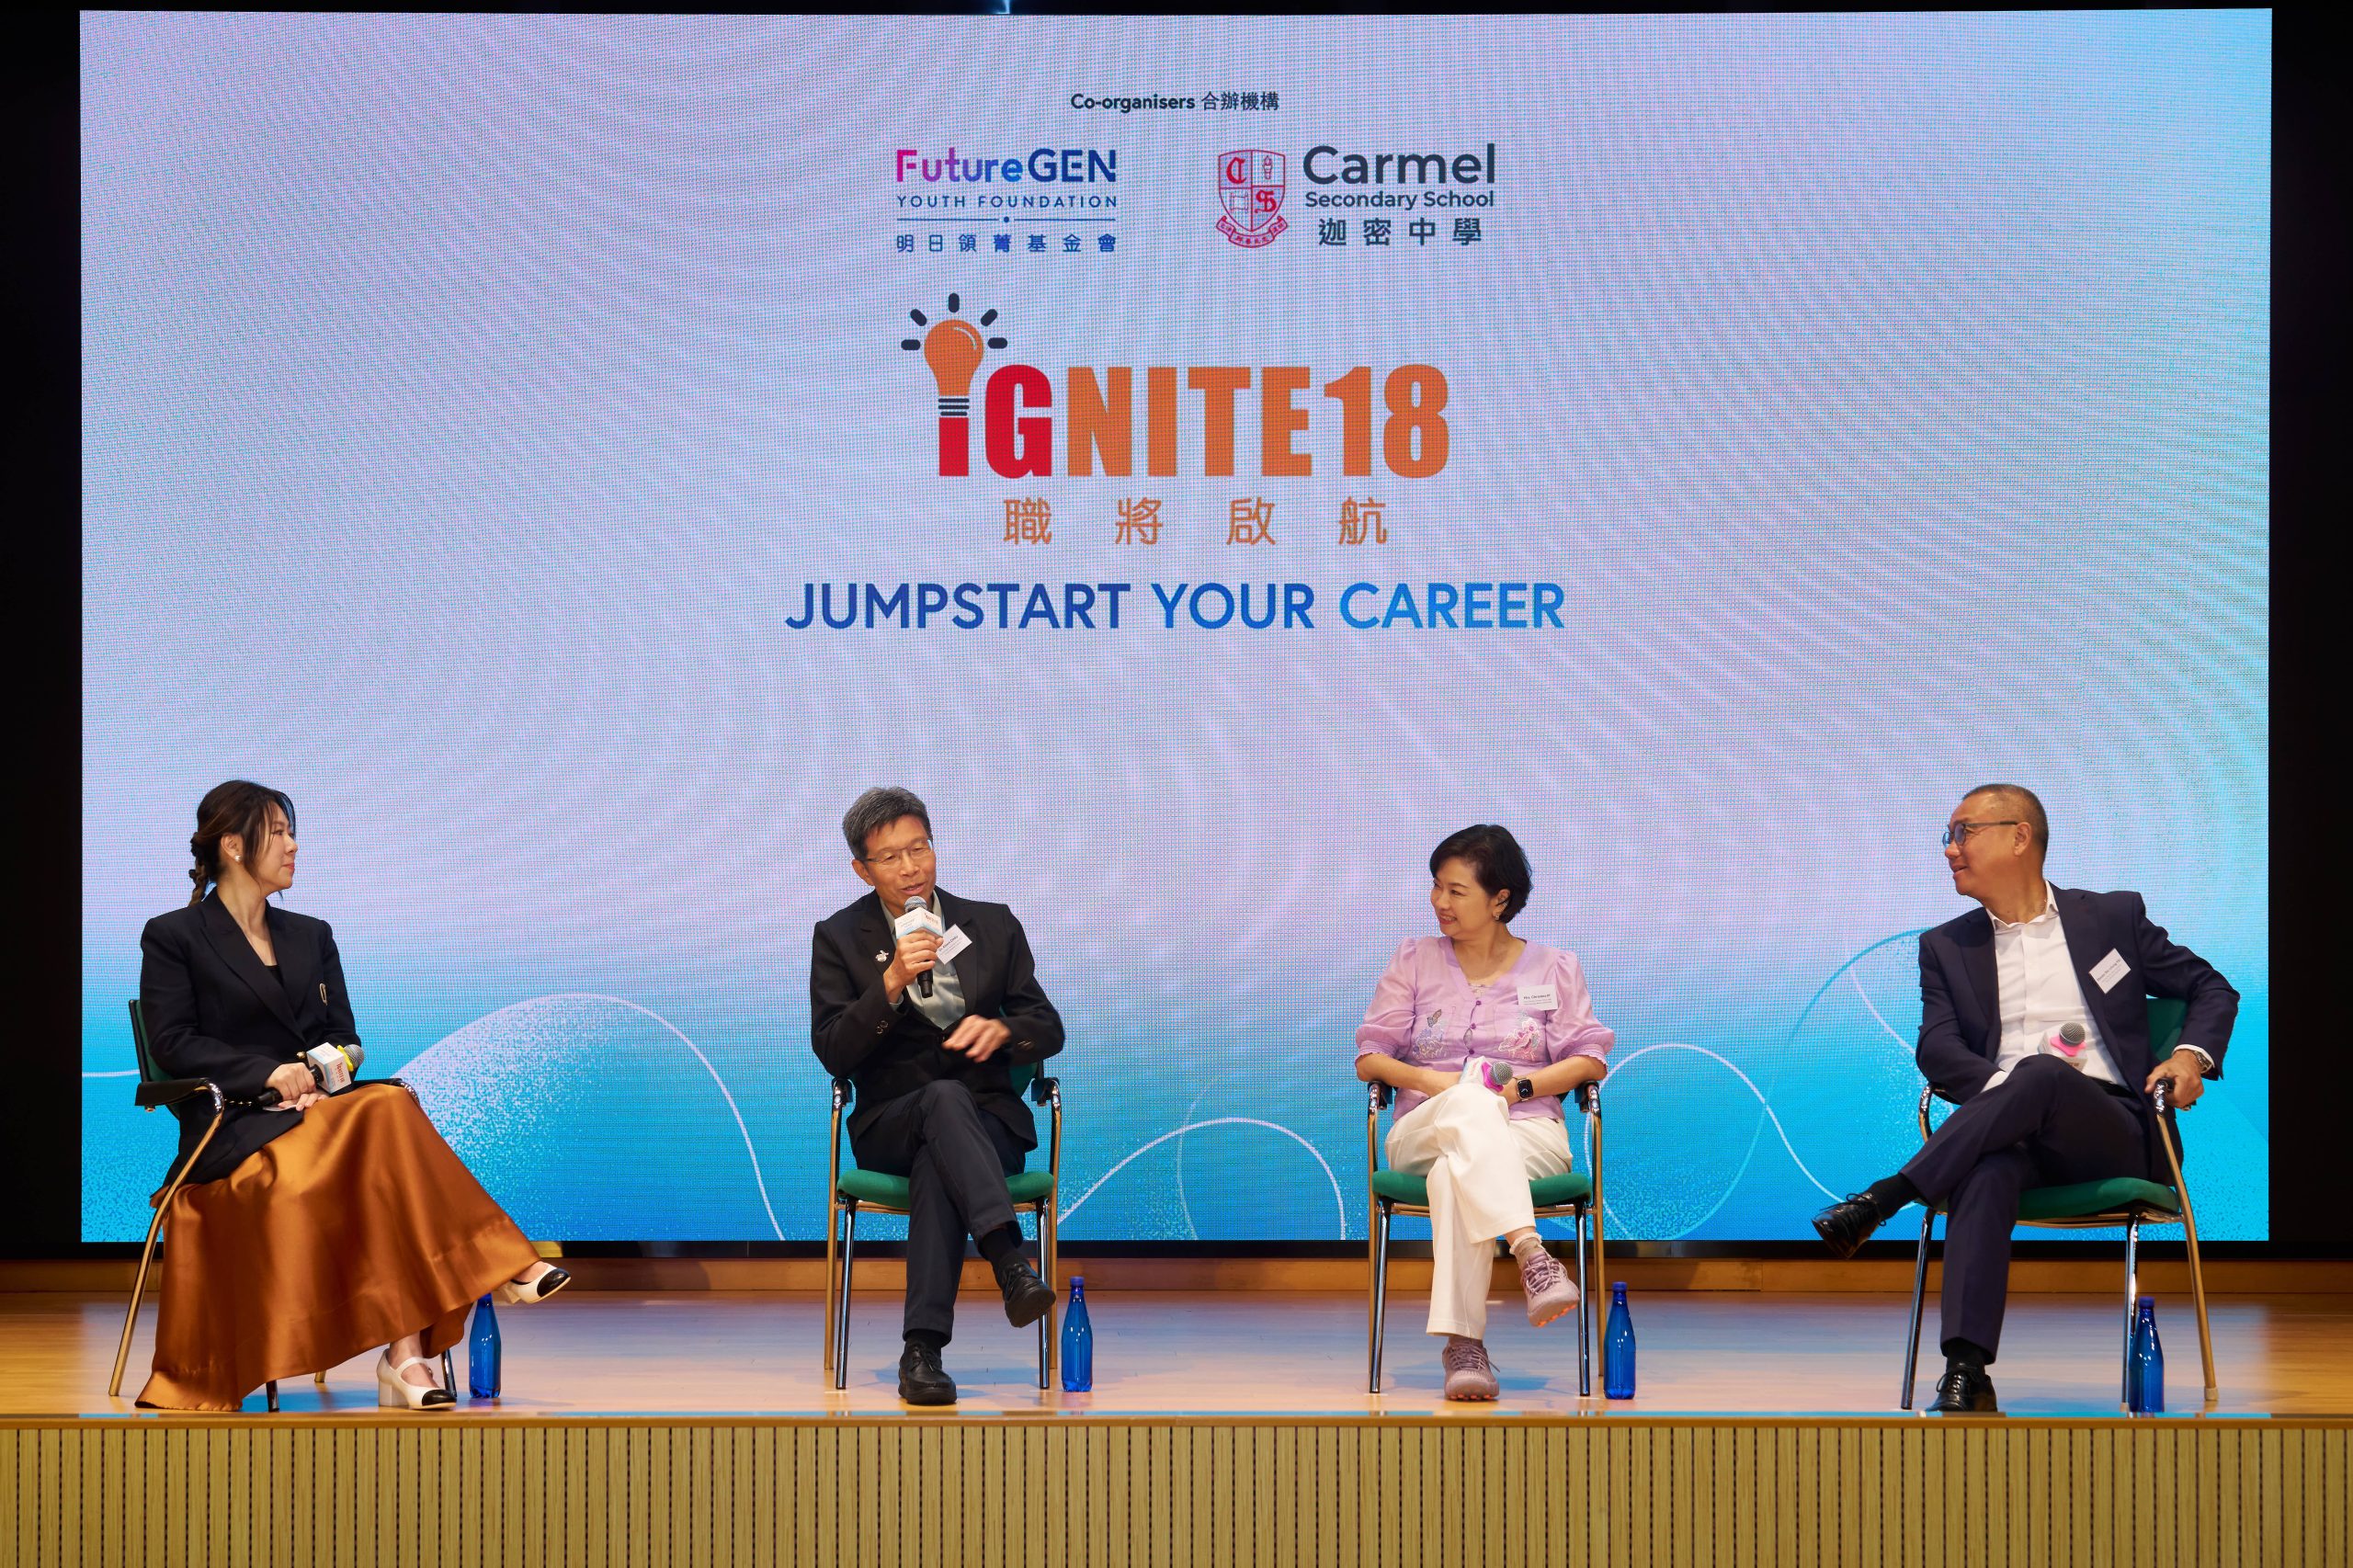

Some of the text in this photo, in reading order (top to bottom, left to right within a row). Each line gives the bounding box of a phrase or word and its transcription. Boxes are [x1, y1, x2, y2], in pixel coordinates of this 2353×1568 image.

[1071, 91, 1279, 113] Co-organisers 合辦機構
[896, 147, 1116, 182] FutureGEN
[1302, 143, 1495, 184] Carmel
[897, 195, 1117, 208] YOUTH FOUNDATION
[1305, 190, 1494, 210] Secondary School
[1318, 217, 1482, 246] 迦密中學
[1003, 496, 1387, 546] 職將啟航
[785, 582, 1564, 630] JUMPSTART YOUR CAREER
